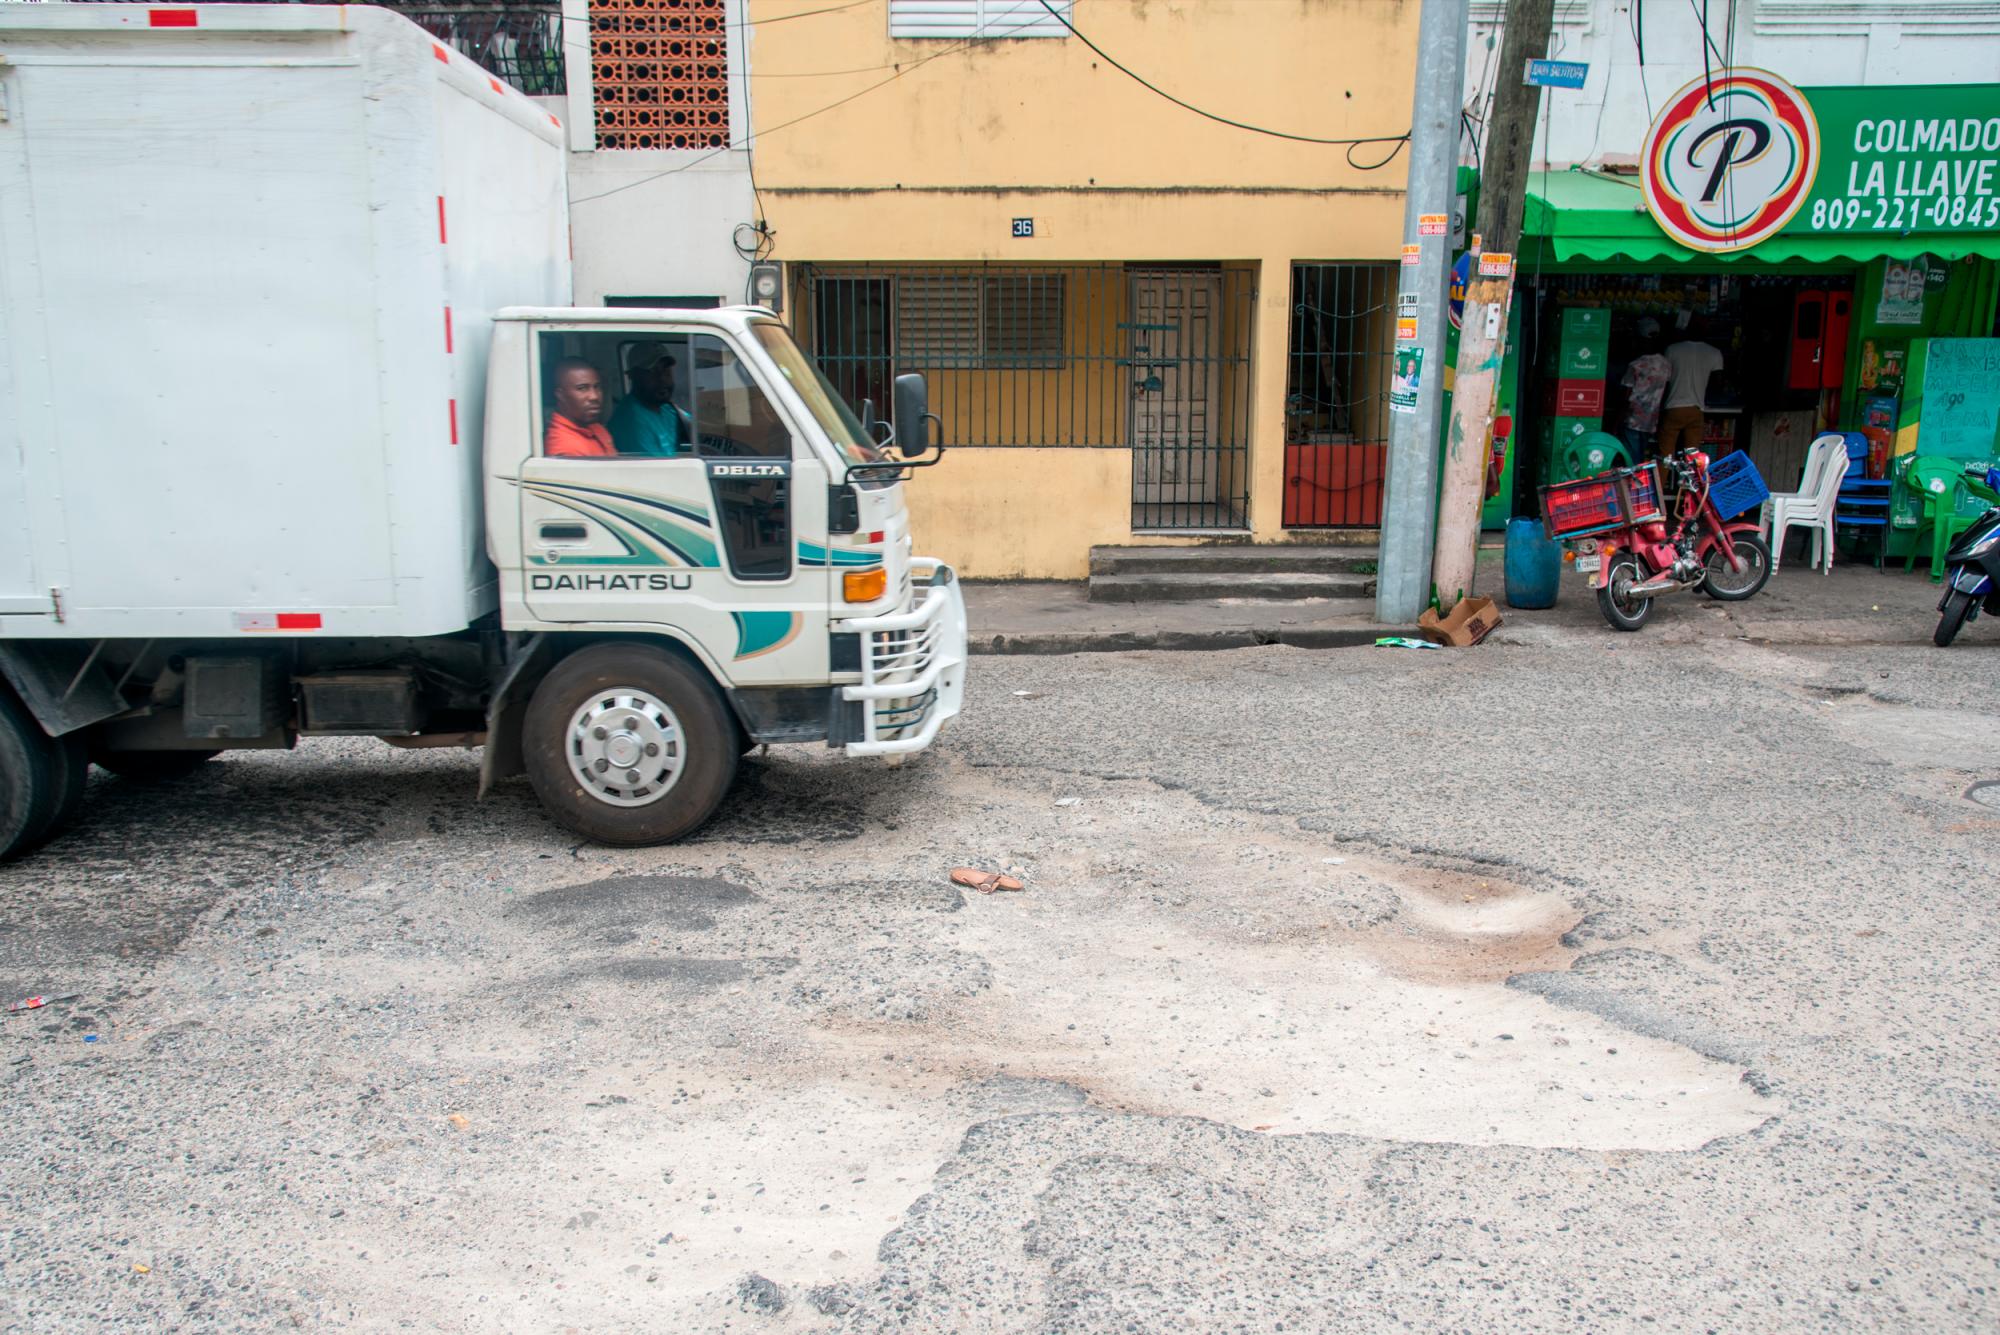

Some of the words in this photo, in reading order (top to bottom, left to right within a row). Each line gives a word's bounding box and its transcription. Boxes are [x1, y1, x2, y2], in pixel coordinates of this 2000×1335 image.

[1854, 118, 2000, 153] COLMADO
[1687, 118, 1770, 202] P
[1847, 160, 1885, 197] LA
[1894, 159, 1997, 197] LLAVE
[1438, 214, 1448, 223] TAXI
[1811, 195, 2000, 230] 809-221-0845
[1013, 220, 1032, 235] 36
[713, 464, 786, 476] DELTA
[532, 574, 692, 591] DAIHATSU
